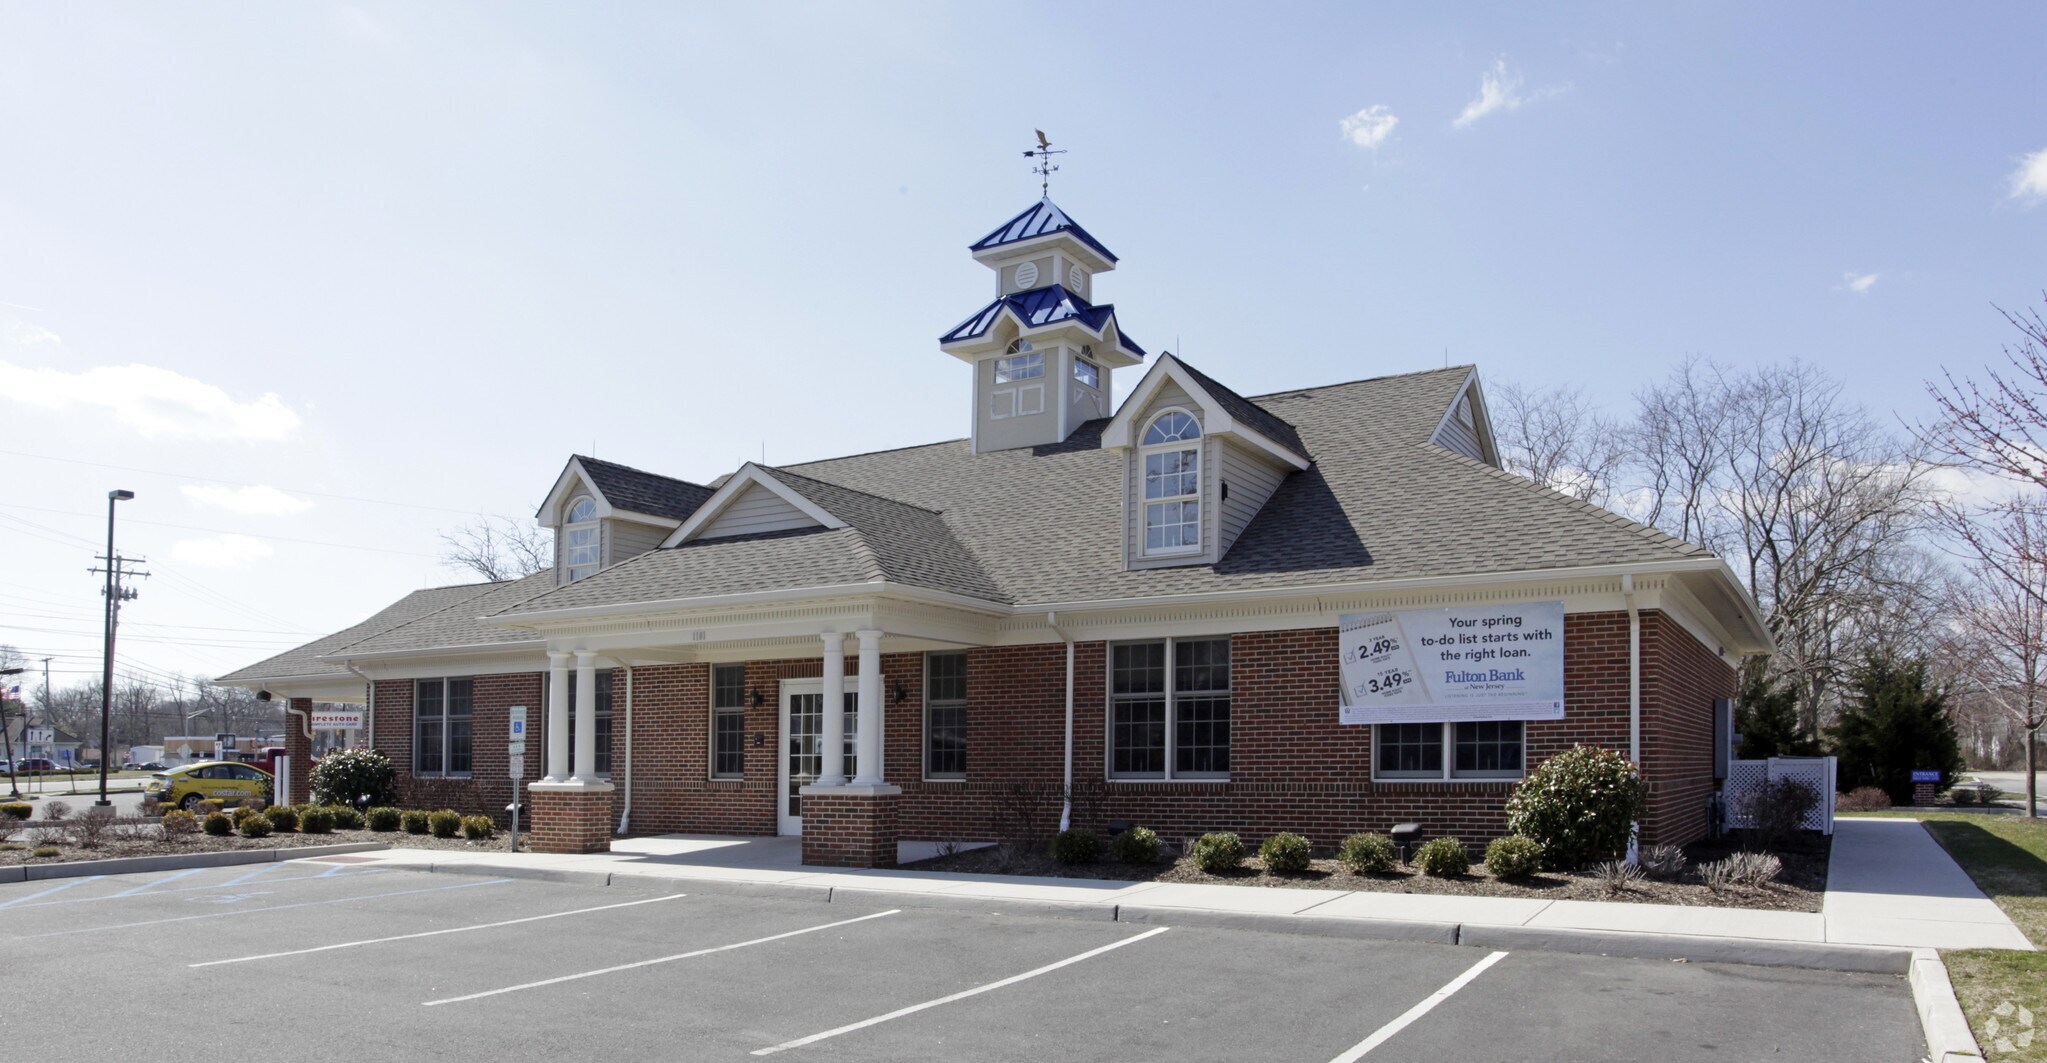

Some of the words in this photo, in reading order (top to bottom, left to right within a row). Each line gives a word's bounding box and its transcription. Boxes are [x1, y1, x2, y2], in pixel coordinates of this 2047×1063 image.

[1449, 617, 1478, 628] Your
[1482, 615, 1522, 629] spring
[1421, 634, 1455, 646] to-do
[1459, 633, 1478, 644] list
[1482, 632, 1519, 643] starts
[1523, 628, 1552, 641] with
[1440, 649, 1461, 661] the
[1465, 648, 1496, 662] right
[1500, 647, 1531, 658] loan.
[1445, 670, 1487, 683] Fulton
[1489, 668, 1525, 682] Bank
[1485, 683, 1505, 691] Jersey
